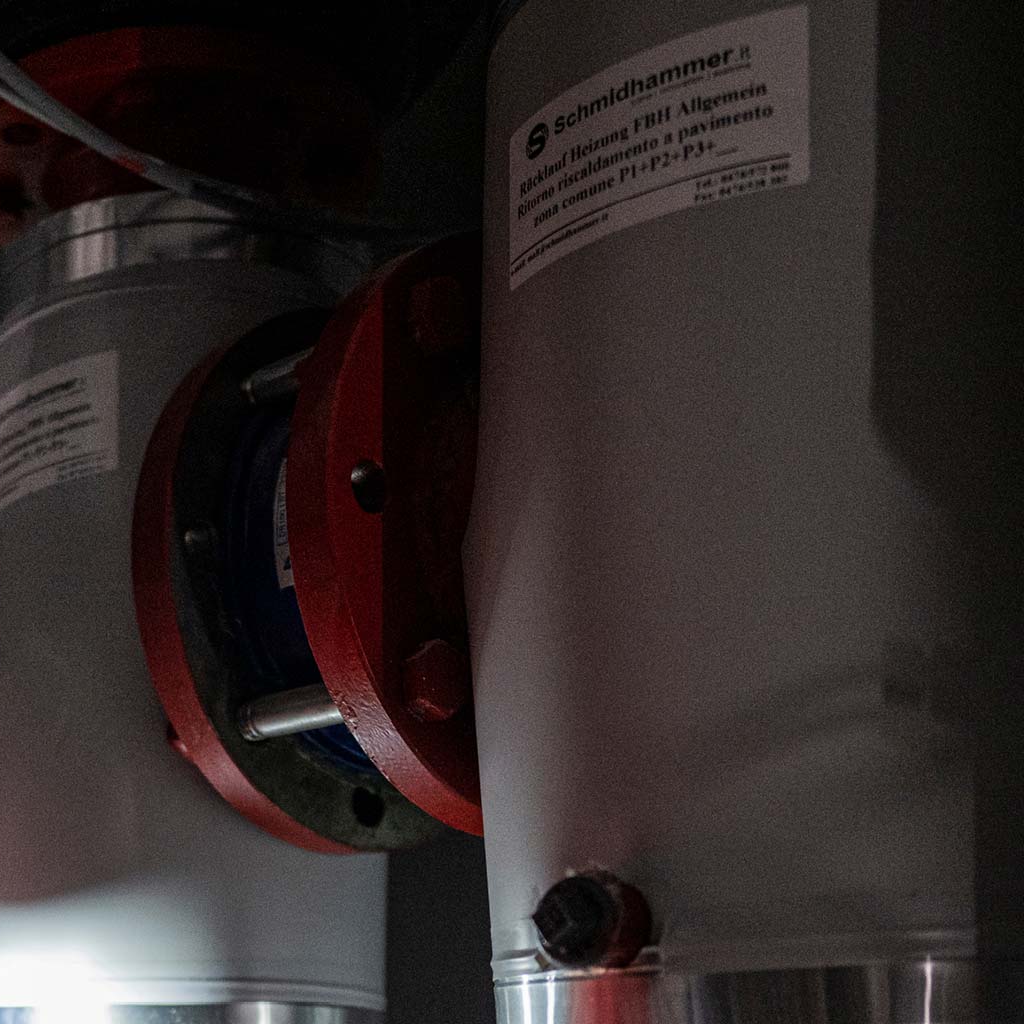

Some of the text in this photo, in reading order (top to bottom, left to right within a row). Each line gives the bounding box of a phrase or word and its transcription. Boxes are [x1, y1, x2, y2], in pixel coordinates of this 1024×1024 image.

[517, 105, 774, 220] Ritorno riscaldamento a pavimento
[570, 126, 629, 164] Heizung
[633, 107, 672, 135] FBH
[677, 82, 767, 116] Allgemein
[533, 205, 559, 228] zona
[562, 175, 616, 209] comune
